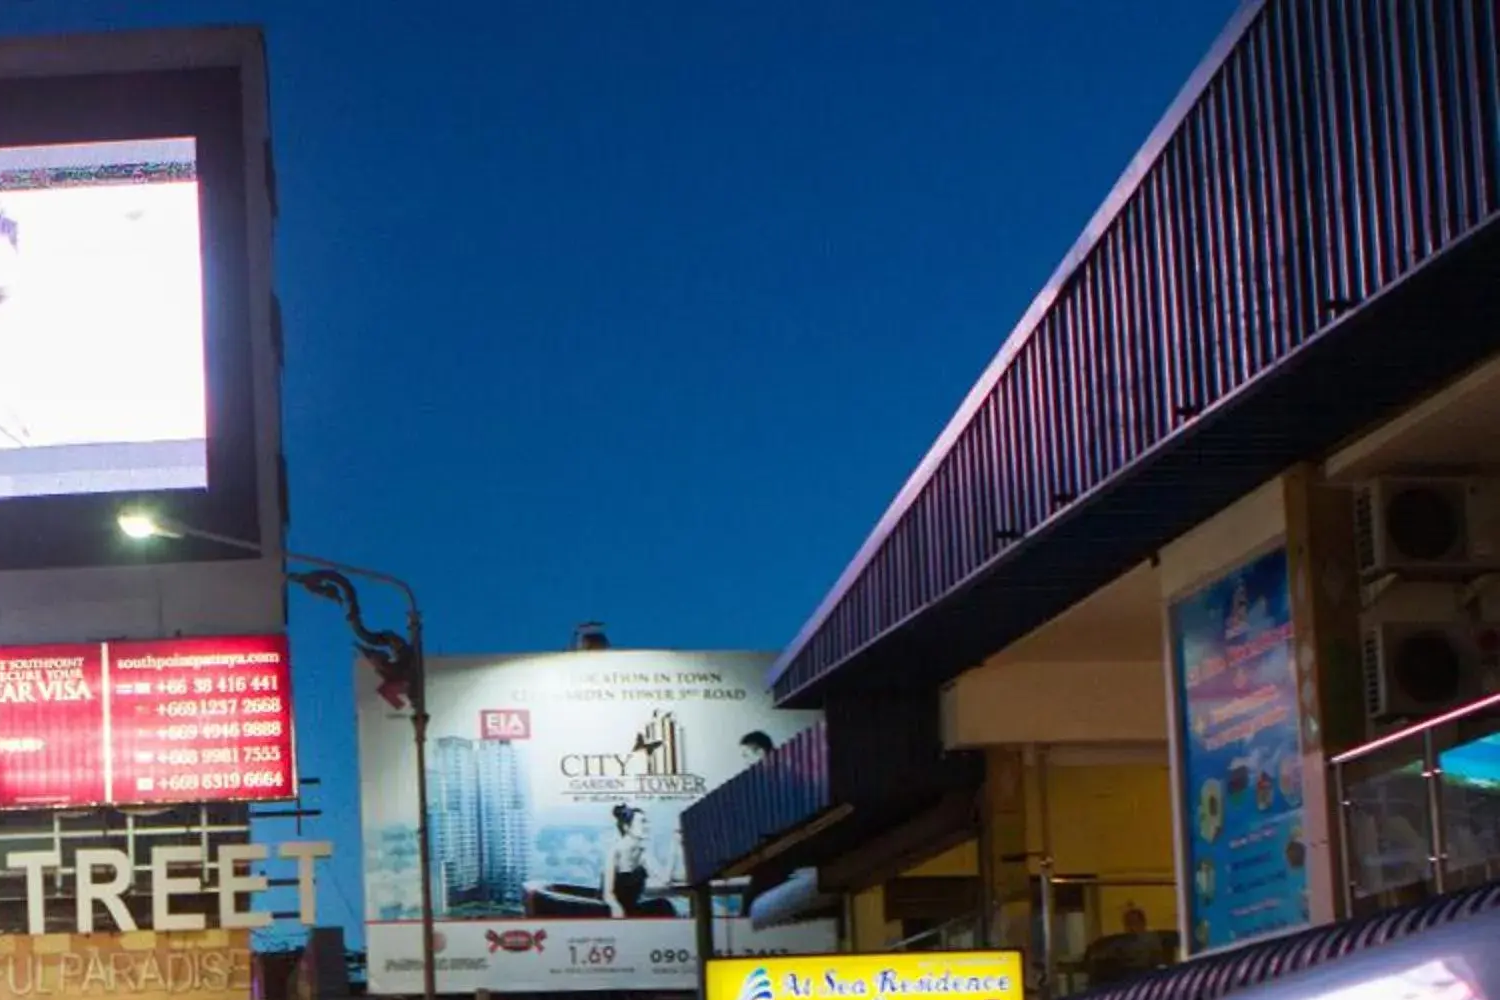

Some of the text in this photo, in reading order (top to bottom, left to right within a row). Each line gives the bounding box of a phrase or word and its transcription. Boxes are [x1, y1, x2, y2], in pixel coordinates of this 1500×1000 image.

[676, 671, 723, 684] TOWN
[38, 680, 95, 702] VISA
[560, 753, 633, 778] CITY
[635, 775, 708, 794] TOWER
[58, 946, 252, 996] PARADISE
[821, 968, 866, 995] Sea
[872, 968, 1012, 993] Residence
